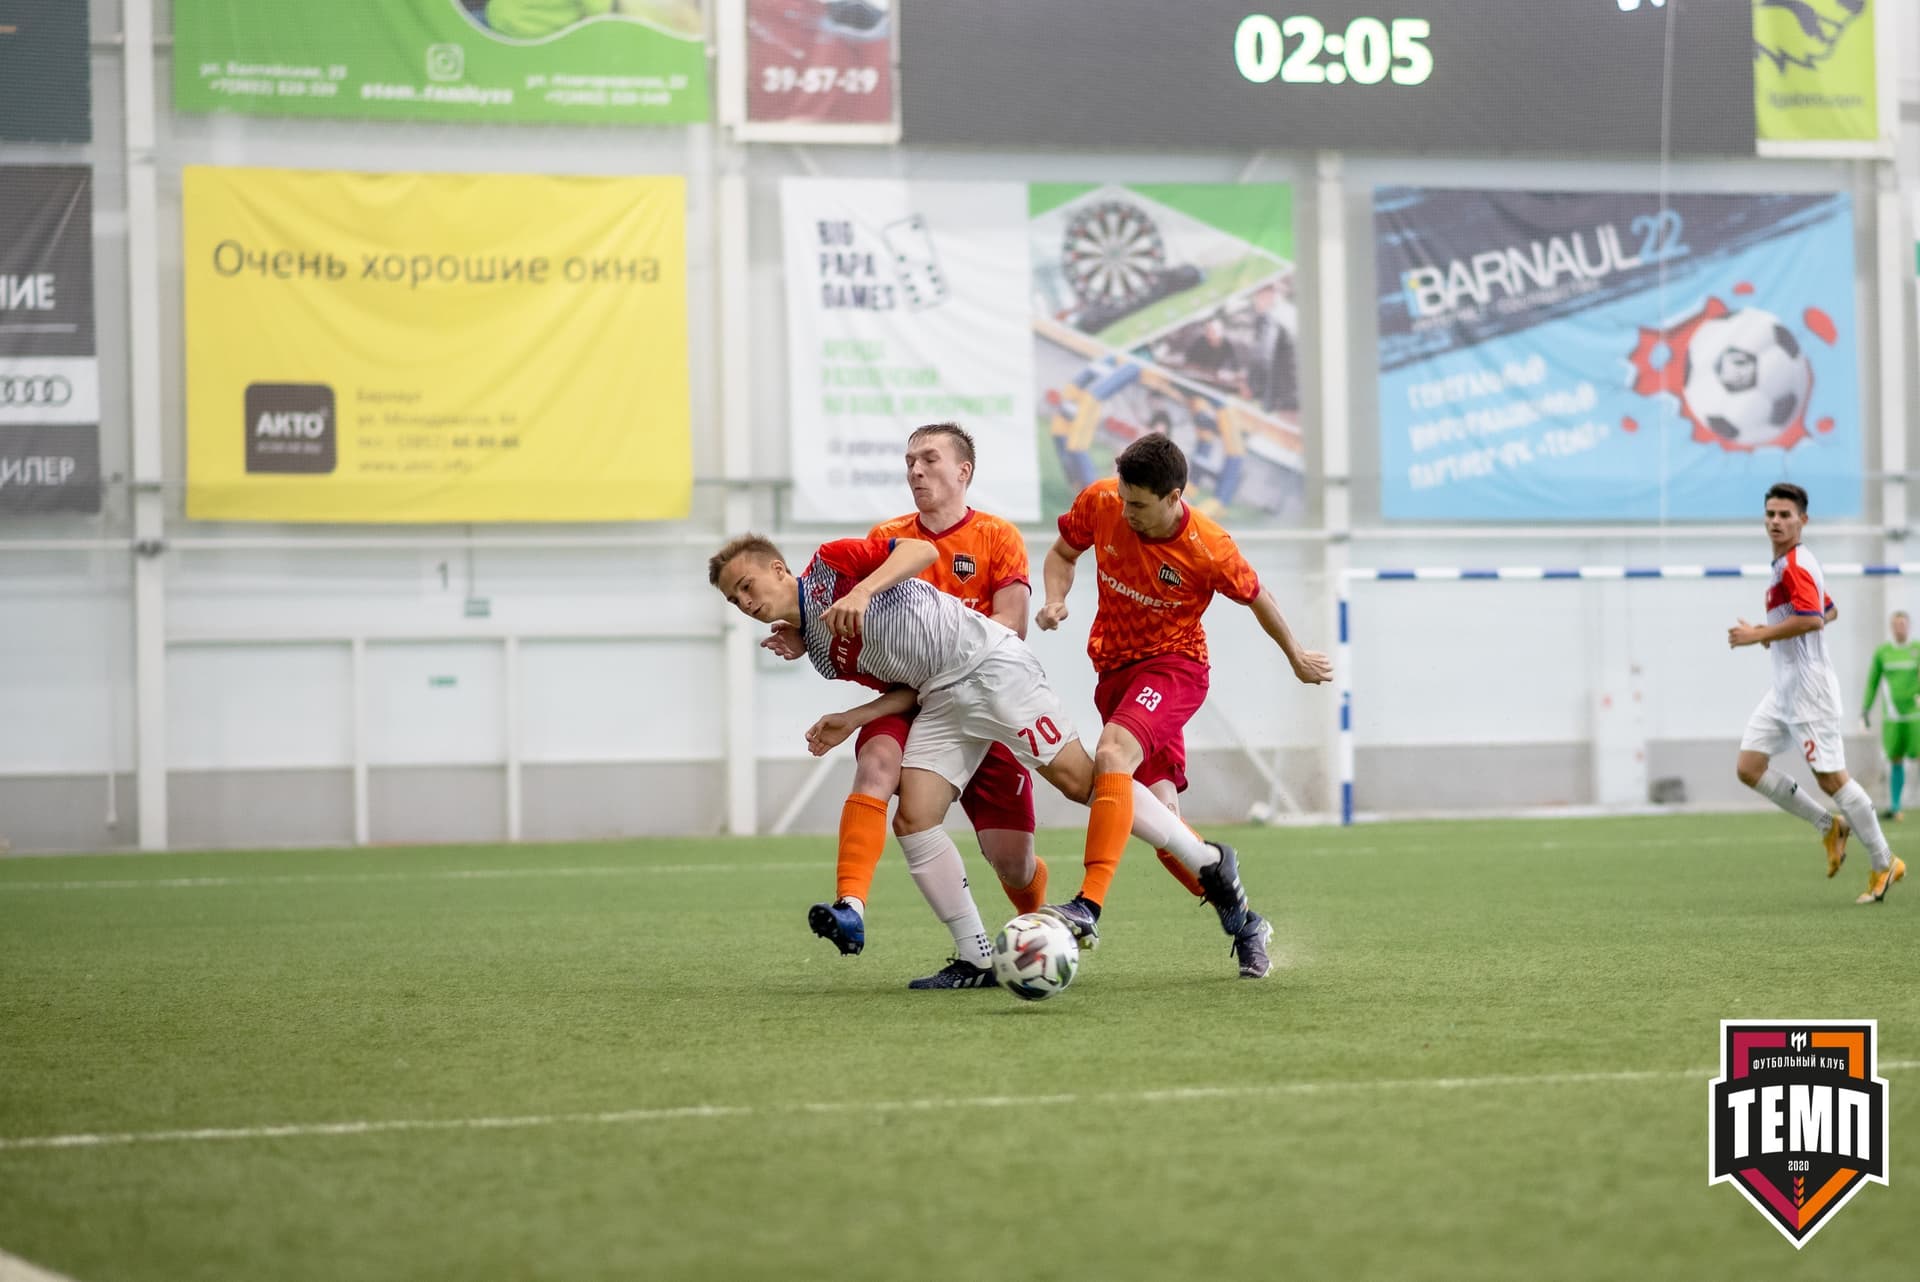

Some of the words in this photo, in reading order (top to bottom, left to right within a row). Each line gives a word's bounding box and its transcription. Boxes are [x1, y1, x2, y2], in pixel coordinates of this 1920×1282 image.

[1234, 13, 1434, 86] 02:05
[212, 239, 348, 281] Очень
[360, 250, 551, 290] хорошие
[563, 256, 661, 285] окна
[954, 560, 974, 574] ТЕМП
[1135, 686, 1162, 712] 23
[1017, 715, 1062, 757] 70
[1804, 738, 1816, 763] 2
